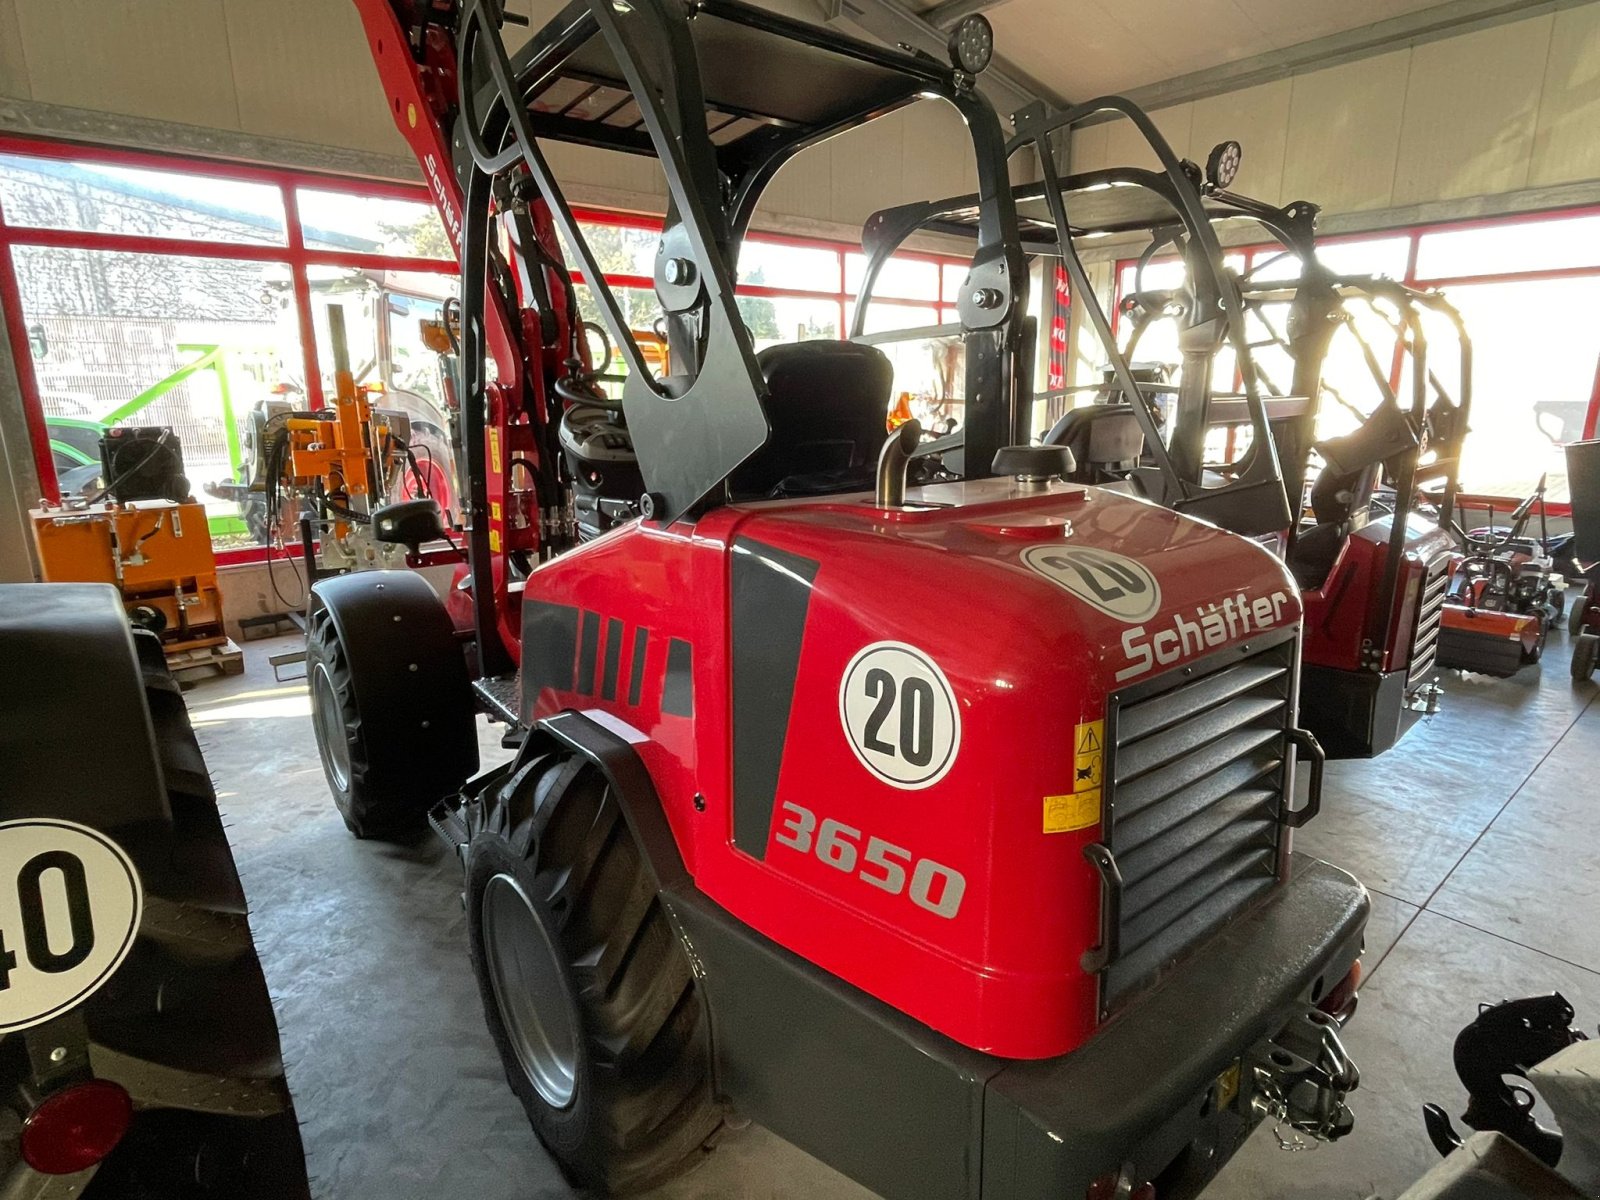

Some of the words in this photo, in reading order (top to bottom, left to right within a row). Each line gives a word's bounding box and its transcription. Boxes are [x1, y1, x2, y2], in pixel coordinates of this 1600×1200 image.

[424, 153, 462, 253] Schäff
[1041, 551, 1146, 602] 20
[1115, 591, 1288, 682] Schäffer
[863, 668, 935, 767] 20
[775, 800, 967, 920] 3650
